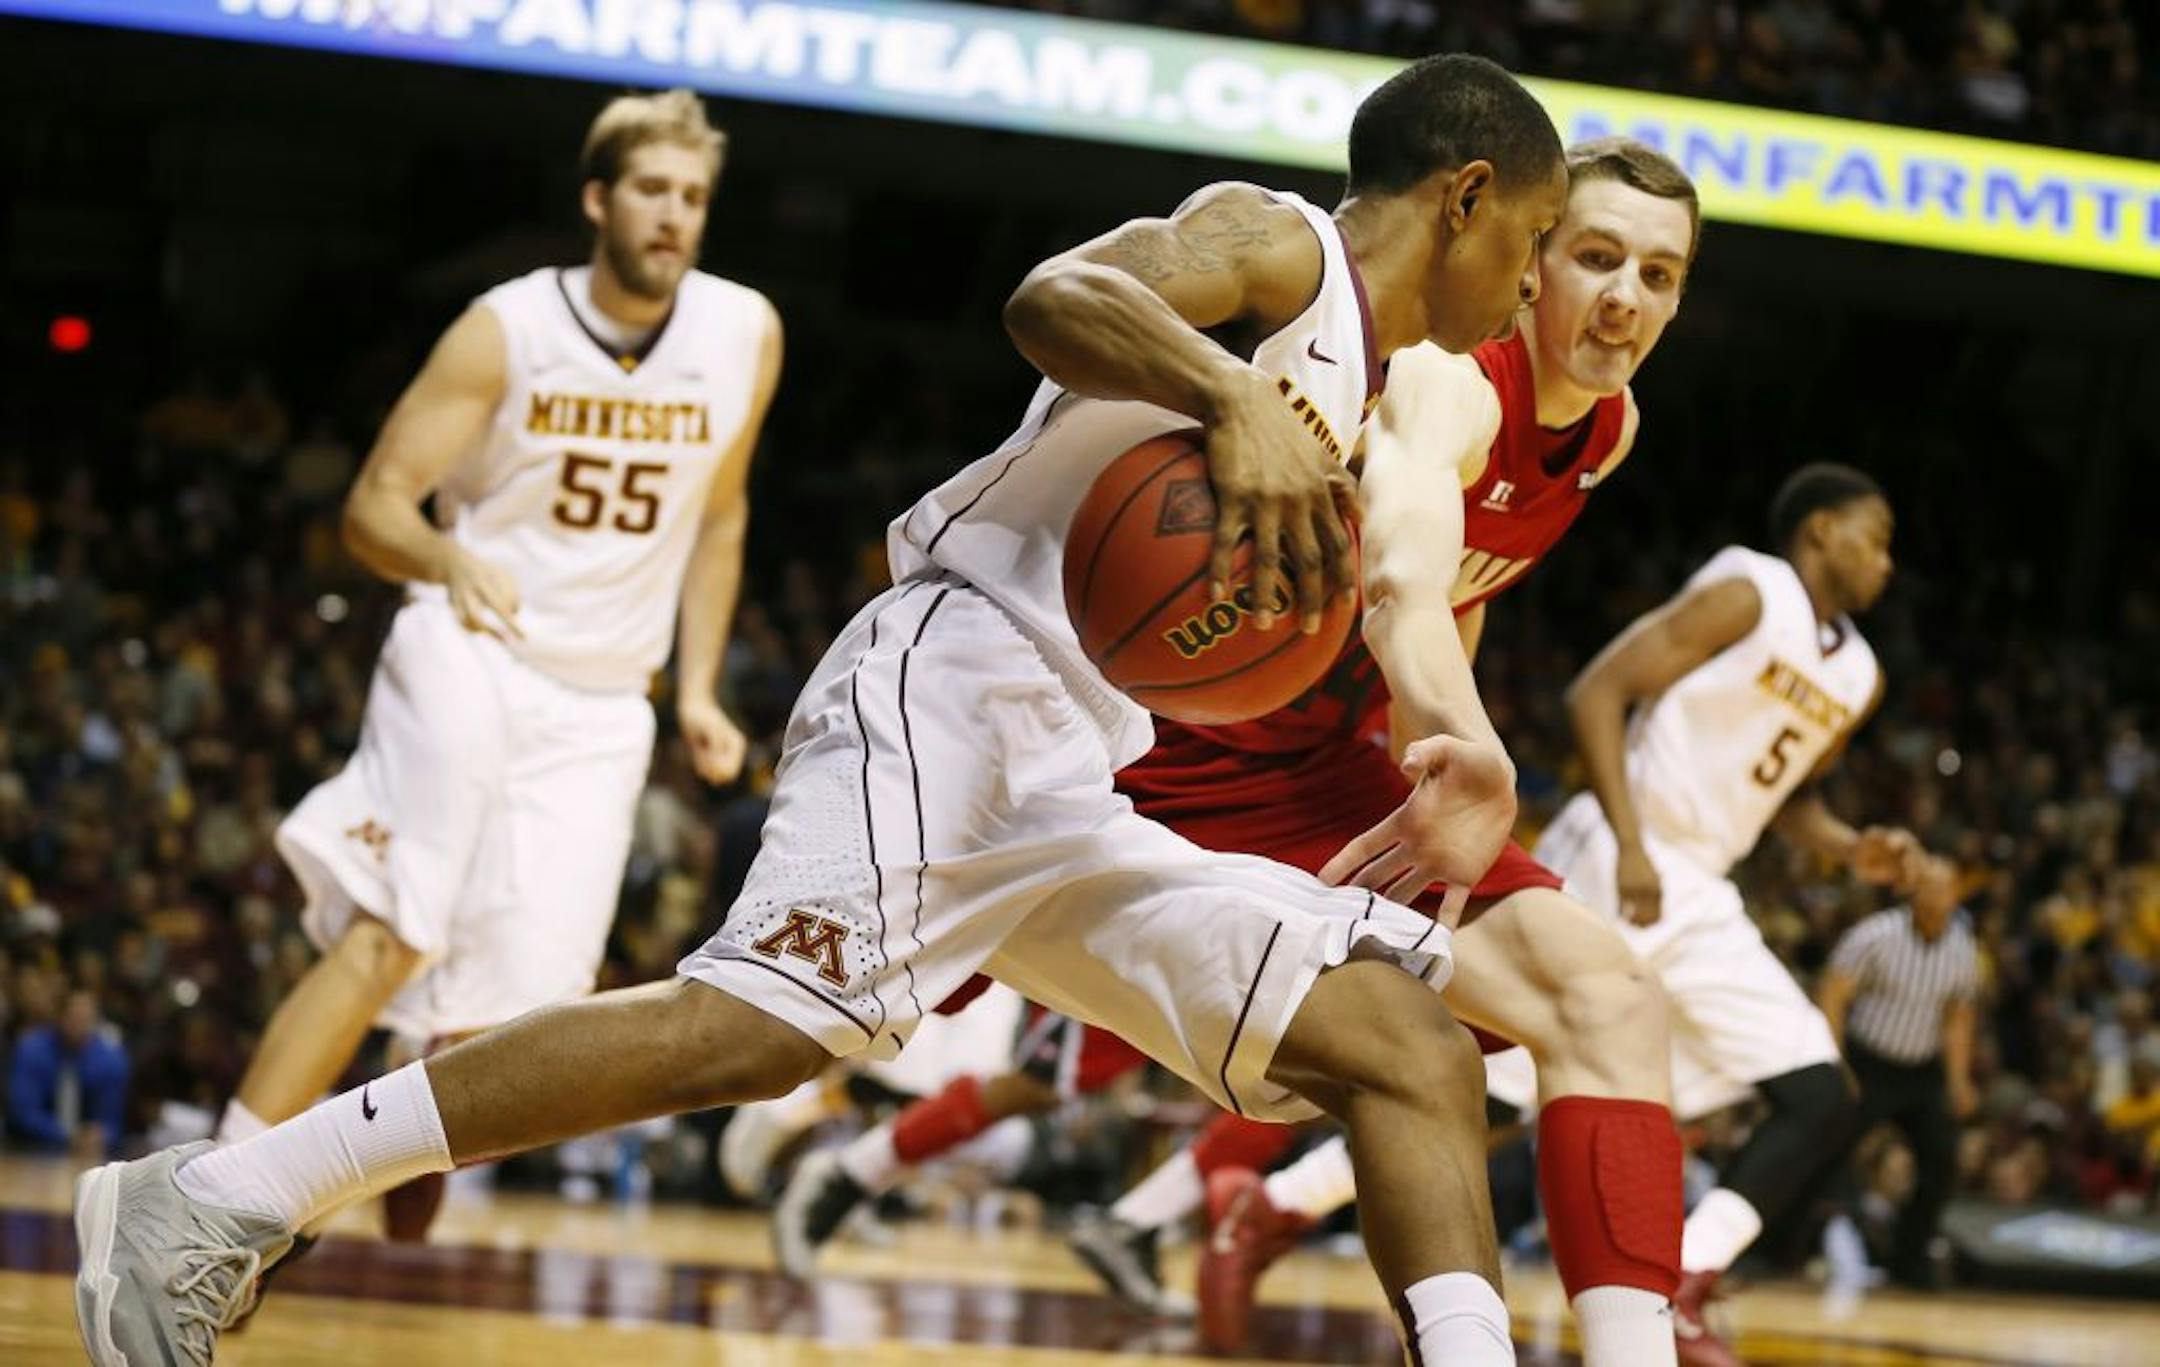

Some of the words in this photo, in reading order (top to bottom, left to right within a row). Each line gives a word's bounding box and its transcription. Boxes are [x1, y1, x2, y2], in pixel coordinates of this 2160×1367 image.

[219, 0, 1388, 143] FARMTEAM.CO
[526, 389, 712, 447] MINNESOTA
[551, 450, 671, 537] 55
[1751, 726, 1804, 787] 5
[751, 907, 850, 988] M
